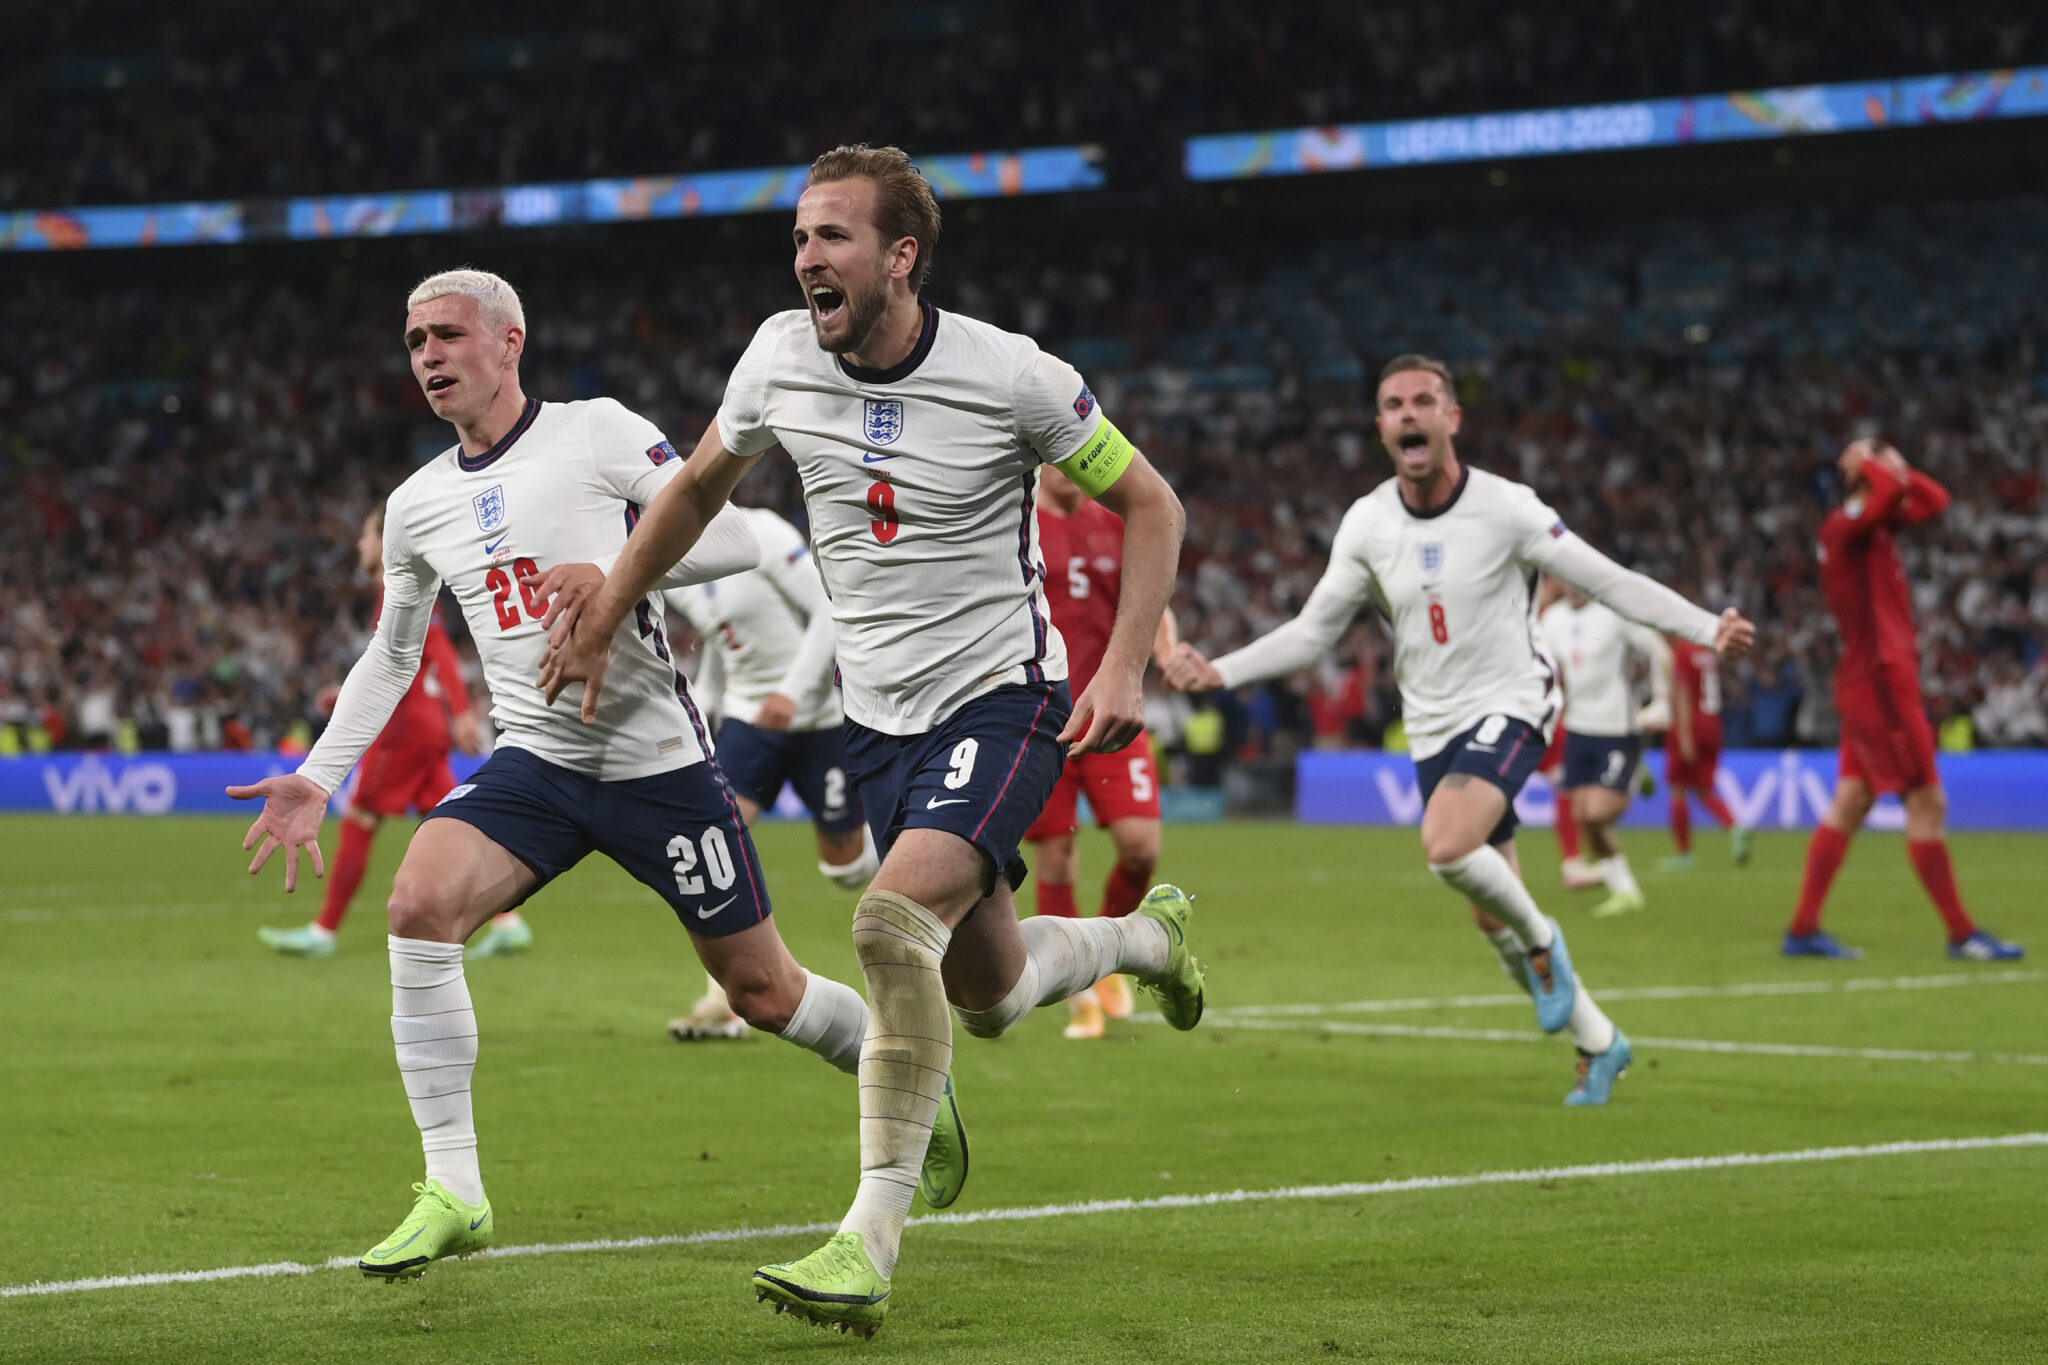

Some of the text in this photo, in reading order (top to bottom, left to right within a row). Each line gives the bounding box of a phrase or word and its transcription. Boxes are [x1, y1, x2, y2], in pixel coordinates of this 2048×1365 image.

[1386, 102, 1655, 164] UEFA EURO 2020
[1079, 438, 1108, 472] #EQUAL
[867, 481, 899, 545] 9
[485, 557, 550, 631] 20
[1068, 555, 1091, 600] 5
[1429, 603, 1449, 646] 8
[1475, 714, 1509, 746] 8
[943, 737, 979, 790] 9
[1127, 757, 1153, 803] 5
[824, 766, 847, 809] 2
[666, 826, 736, 896] 20
